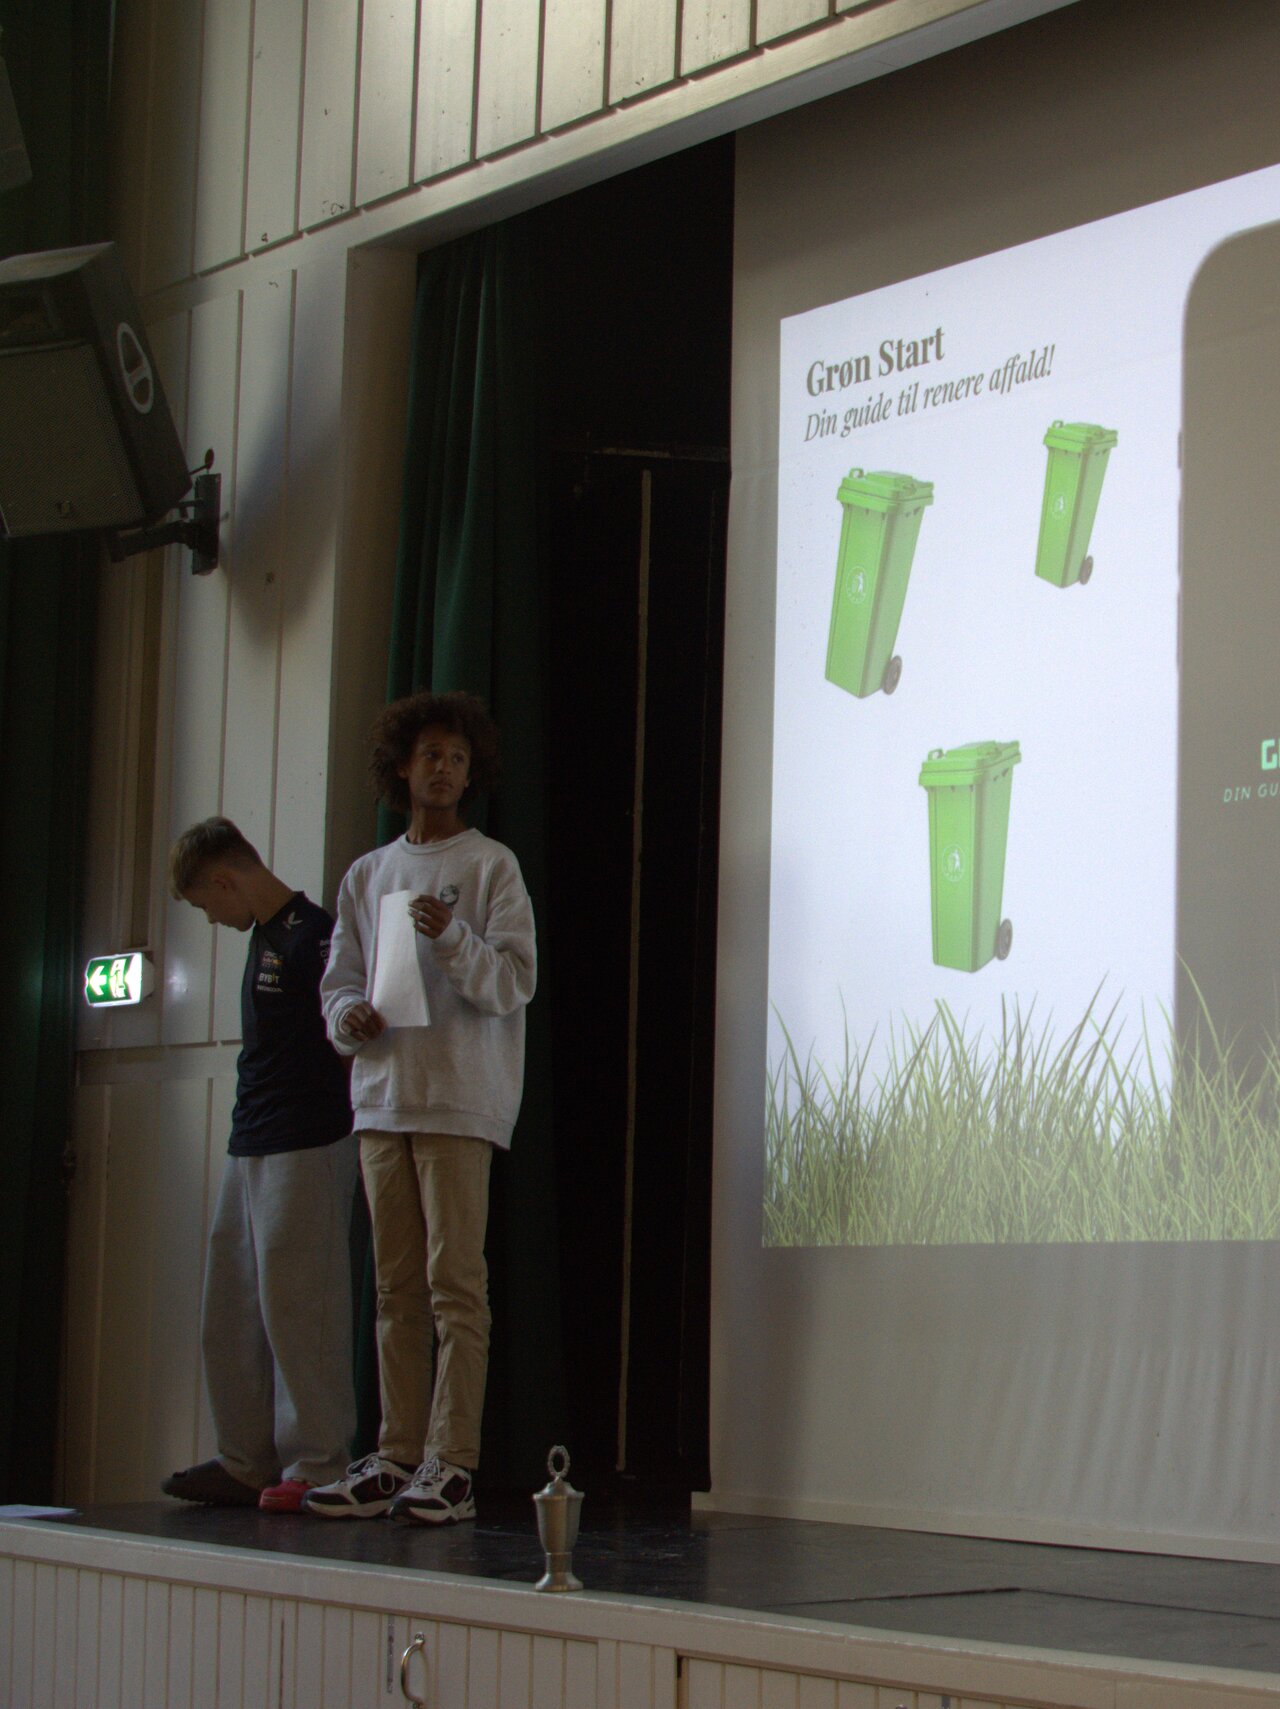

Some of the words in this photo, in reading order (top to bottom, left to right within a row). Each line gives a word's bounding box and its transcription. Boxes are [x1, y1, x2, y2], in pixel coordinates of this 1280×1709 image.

[804, 409, 837, 442] Din
[841, 392, 892, 438] guide
[897, 382, 920, 417] til
[923, 372, 985, 409] renere
[988, 344, 1056, 395] affald!
[806, 354, 871, 397] Grøn
[878, 326, 945, 377] Start
[1223, 786, 1251, 803] DIN
